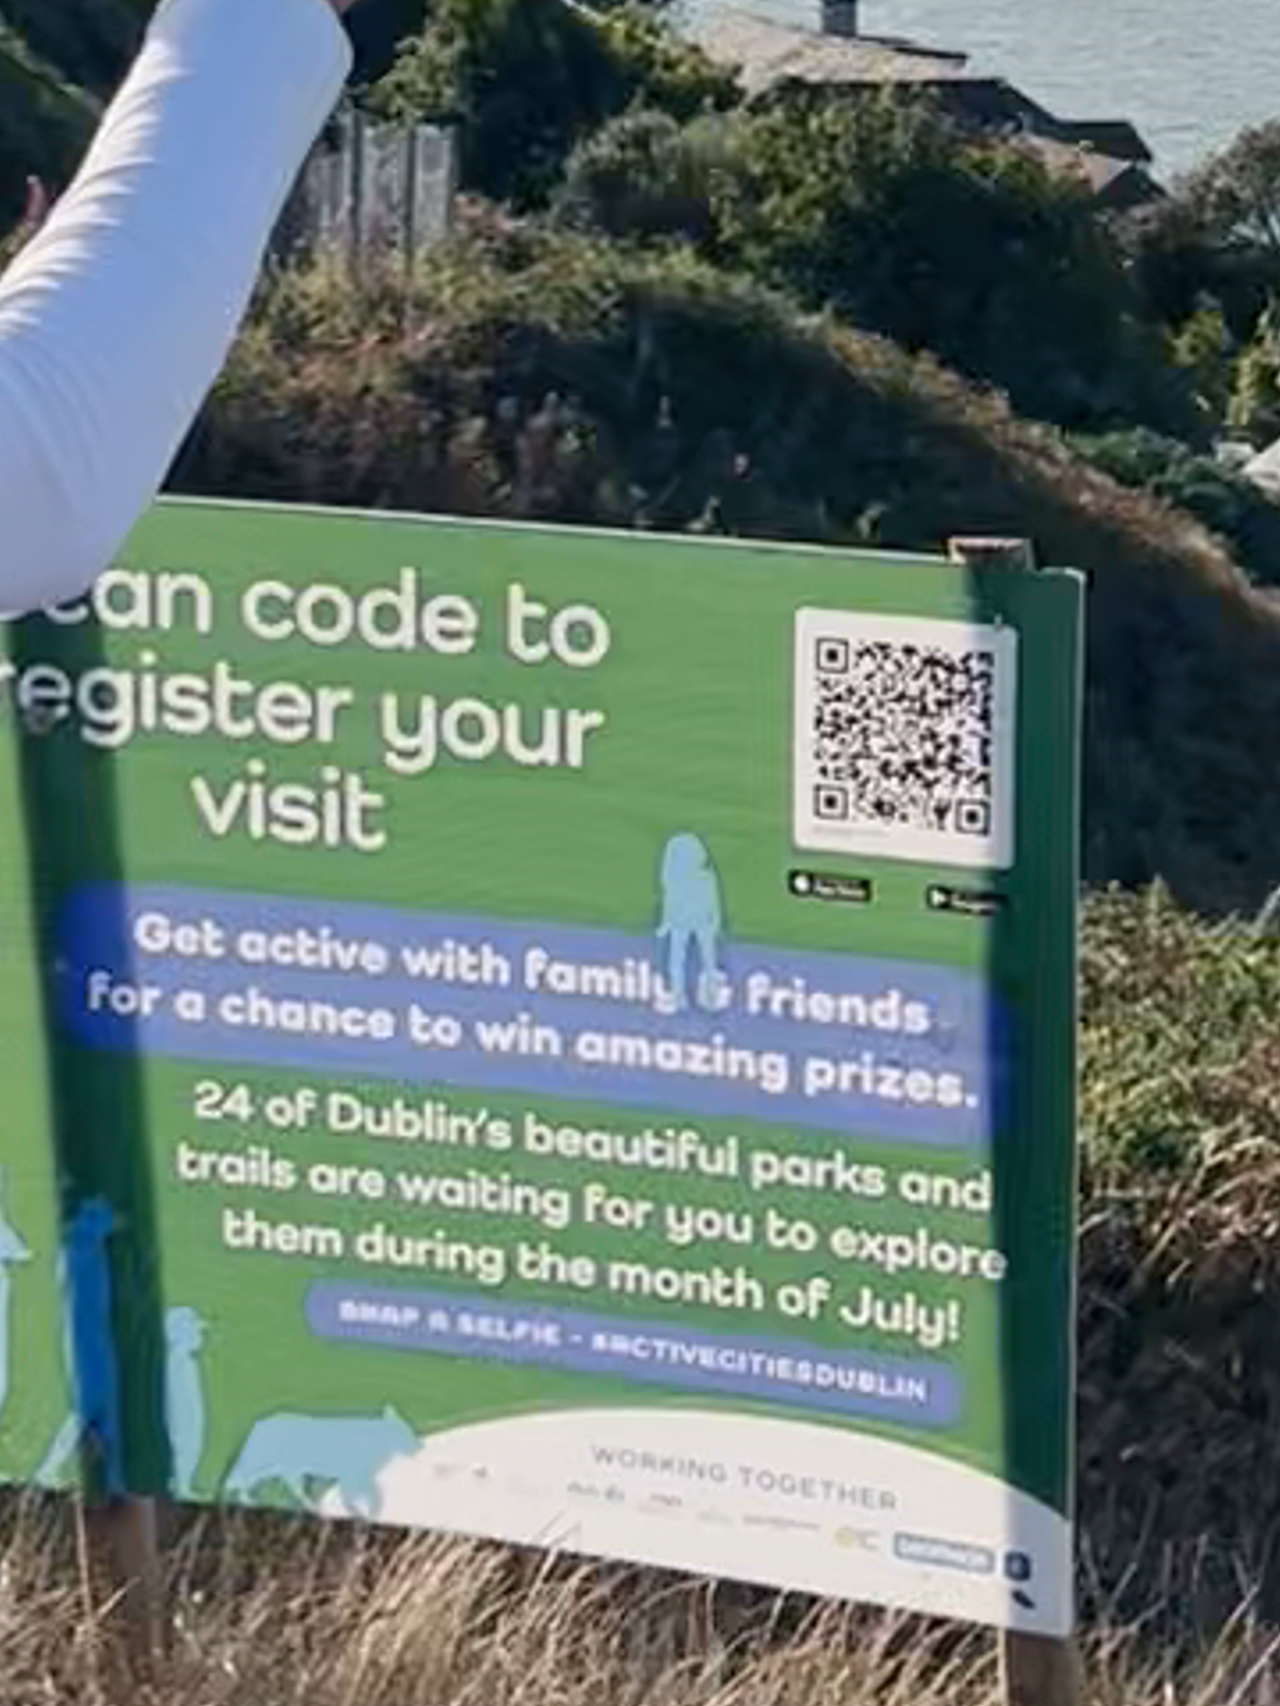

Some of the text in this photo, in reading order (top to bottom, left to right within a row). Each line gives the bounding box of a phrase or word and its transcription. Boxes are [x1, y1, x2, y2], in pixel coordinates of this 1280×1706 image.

[242, 568, 476, 653] code
[507, 582, 610, 666] to
[381, 691, 605, 775] your
[192, 759, 386, 851] visit
[134, 913, 224, 955] Get
[237, 927, 388, 973] active
[403, 940, 510, 985] with
[524, 947, 677, 1014] family
[746, 972, 931, 1033] friends
[87, 972, 978, 1109] for a chance to win amazing prizes.
[194, 1080, 992, 1211] 24 of Dublin's beautiful parks and
[176, 1142, 1007, 1280] trails are waiting for you to explore
[223, 1209, 960, 1347] them during the month of July!
[339, 1300, 419, 1325] SNAP
[457, 1311, 562, 1346] SELFIE
[590, 1444, 898, 1512] WORKING TOGETHER
